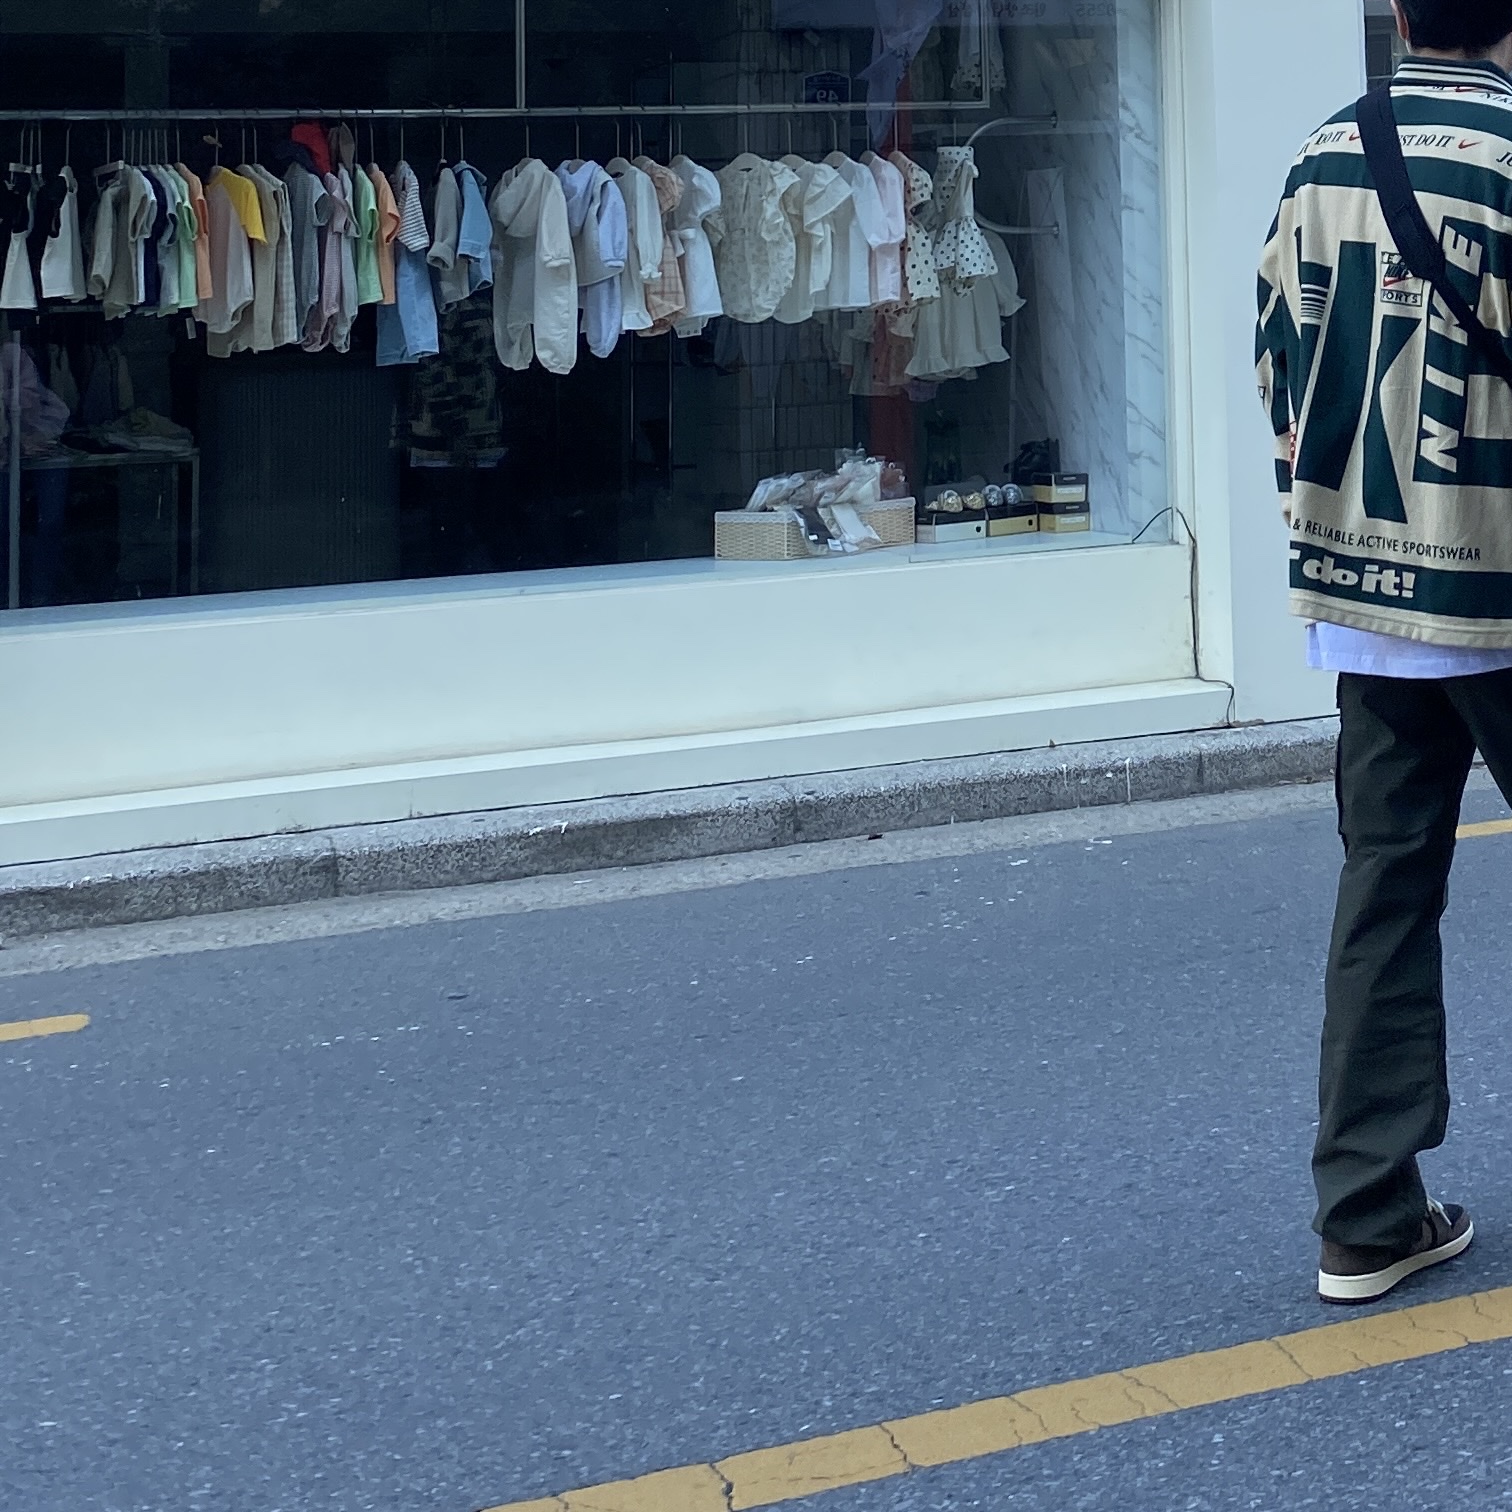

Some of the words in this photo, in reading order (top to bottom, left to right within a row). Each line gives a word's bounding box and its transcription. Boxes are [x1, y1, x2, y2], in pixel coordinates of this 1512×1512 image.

[1417, 134, 1434, 147] DO
[1434, 135, 1455, 148] IT
[1292, 518, 1302, 530] &
[1304, 519, 1354, 546] RELIABLE
[1357, 534, 1398, 552] ACTIVE
[1401, 540, 1481, 561] SPORTSWEAR
[1302, 555, 1359, 586] do
[1361, 564, 1416, 599] it!
